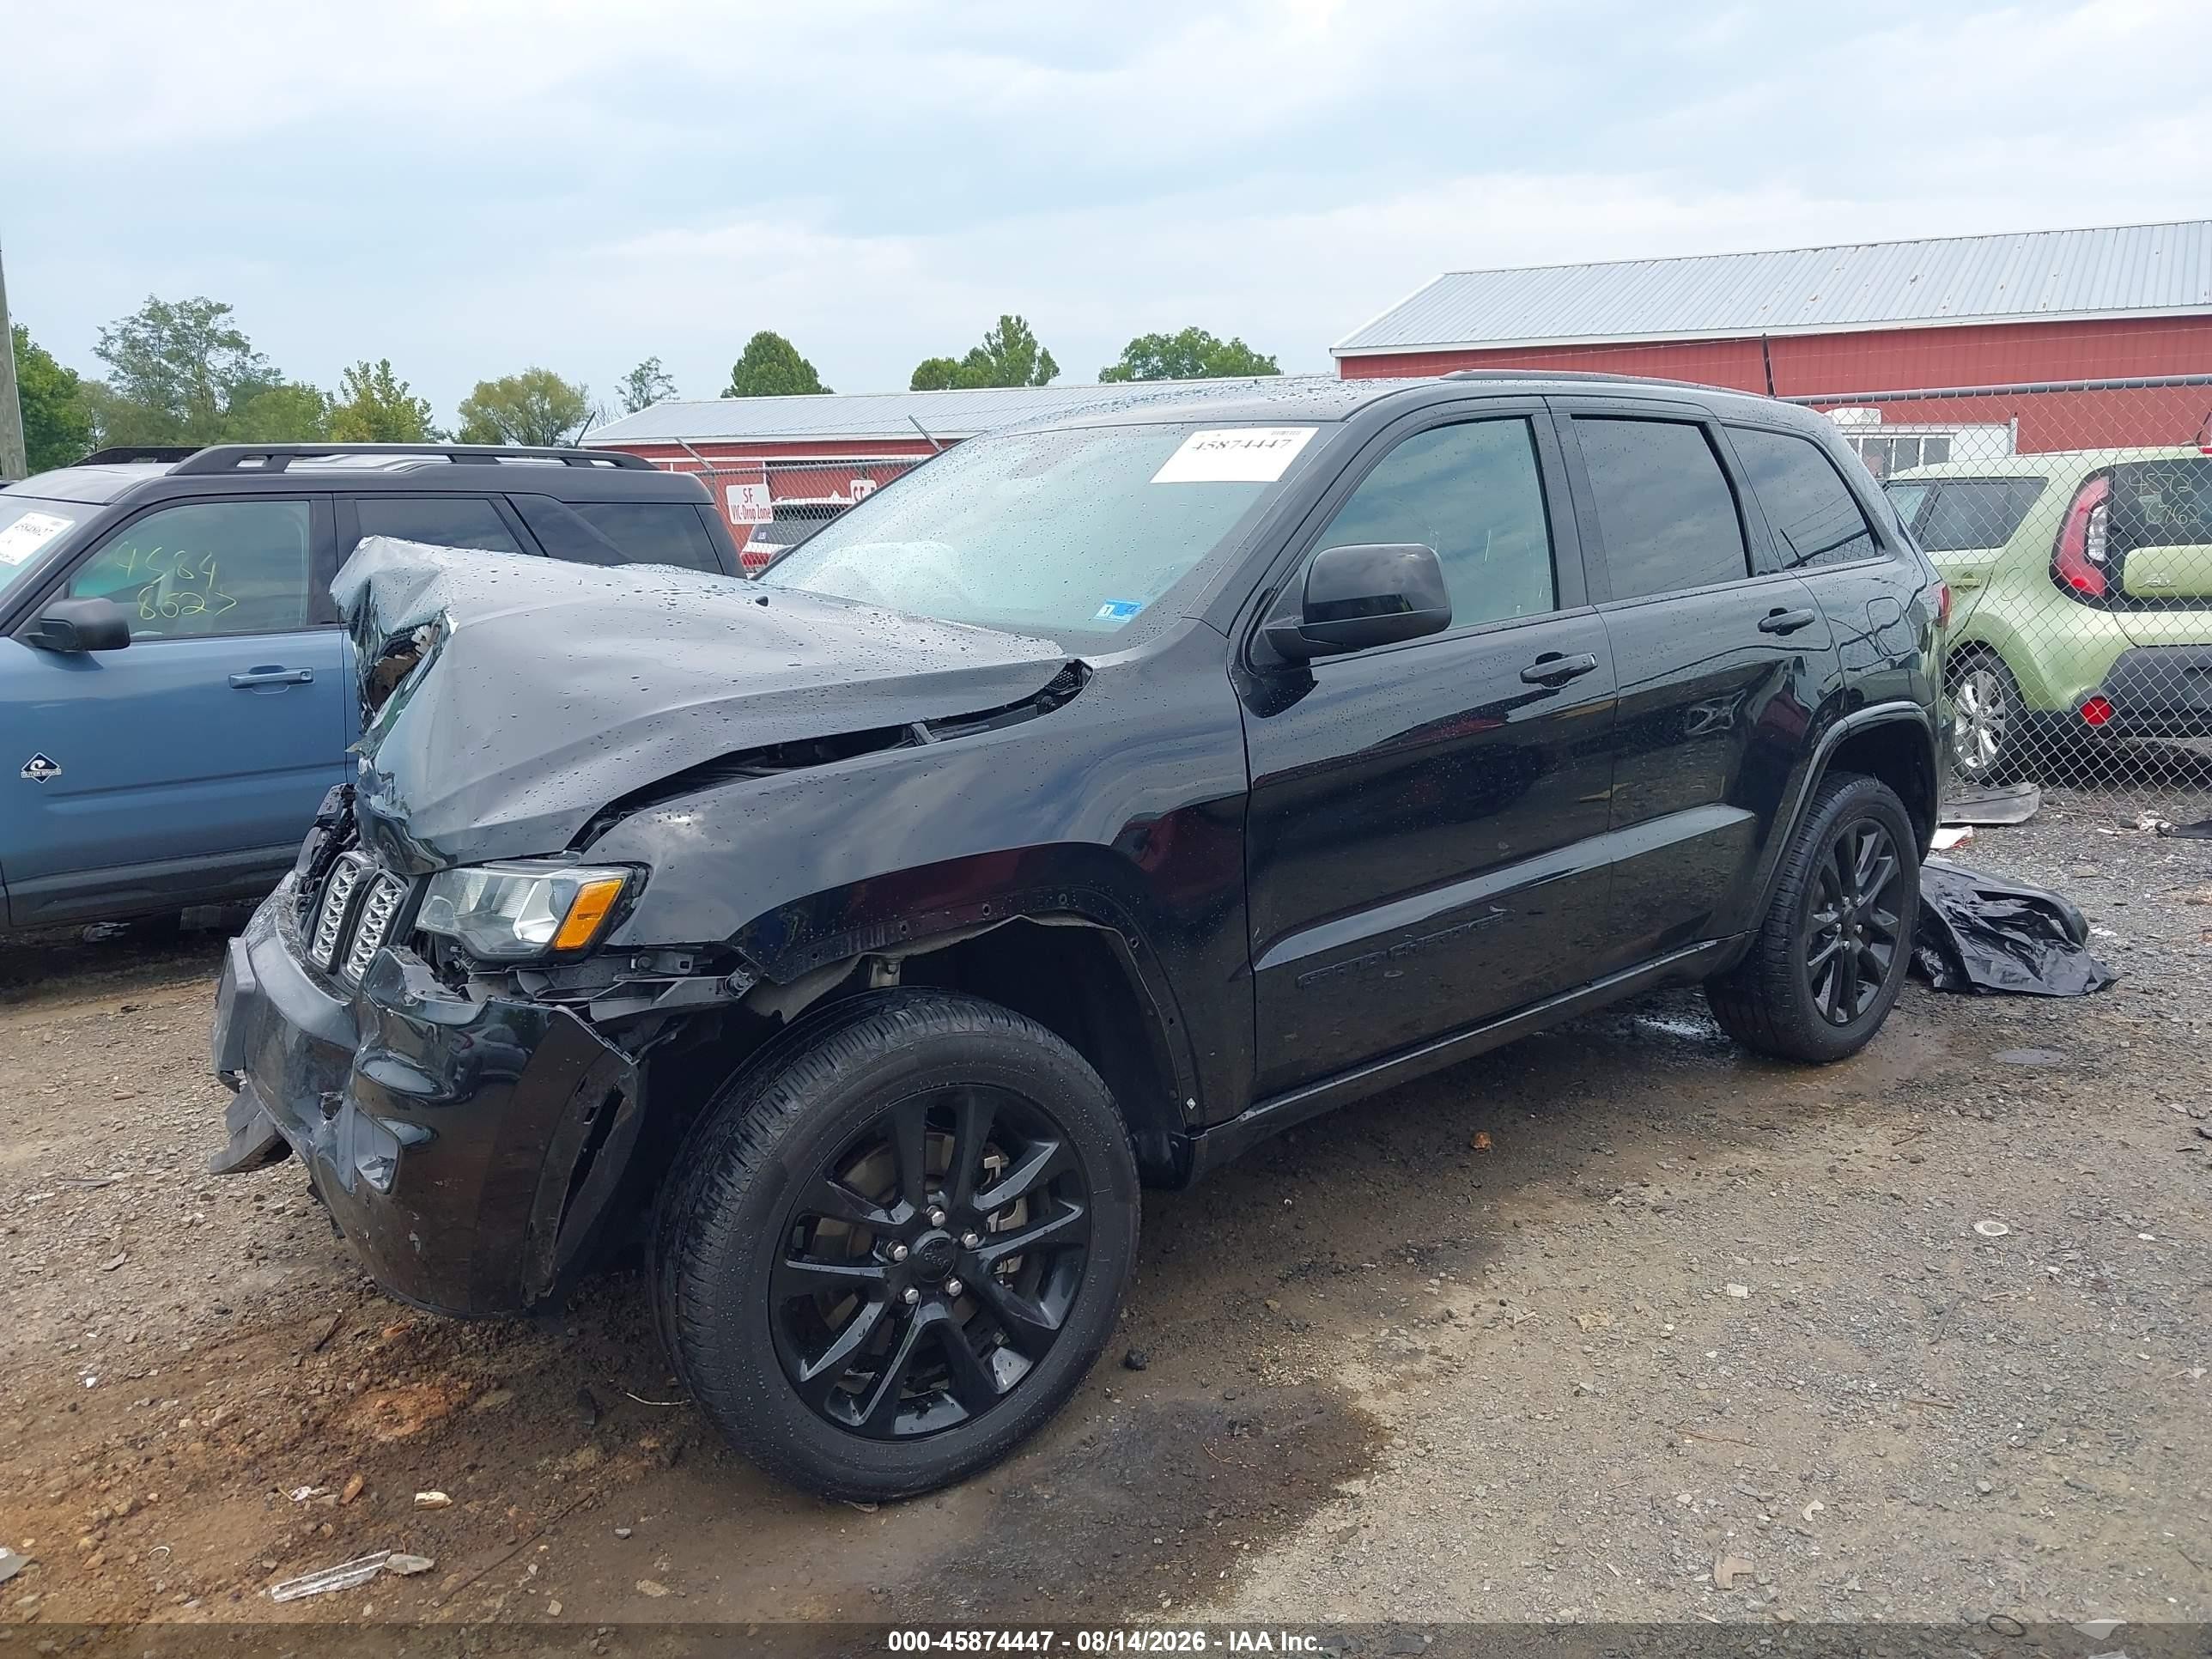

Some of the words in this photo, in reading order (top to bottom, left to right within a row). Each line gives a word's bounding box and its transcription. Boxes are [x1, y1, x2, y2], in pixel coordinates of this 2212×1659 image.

[1191, 438, 1293, 452] 45874447
[743, 487, 754, 503] SF
[730, 503, 757, 522] VIC-Drop
[756, 503, 772, 520] Zone
